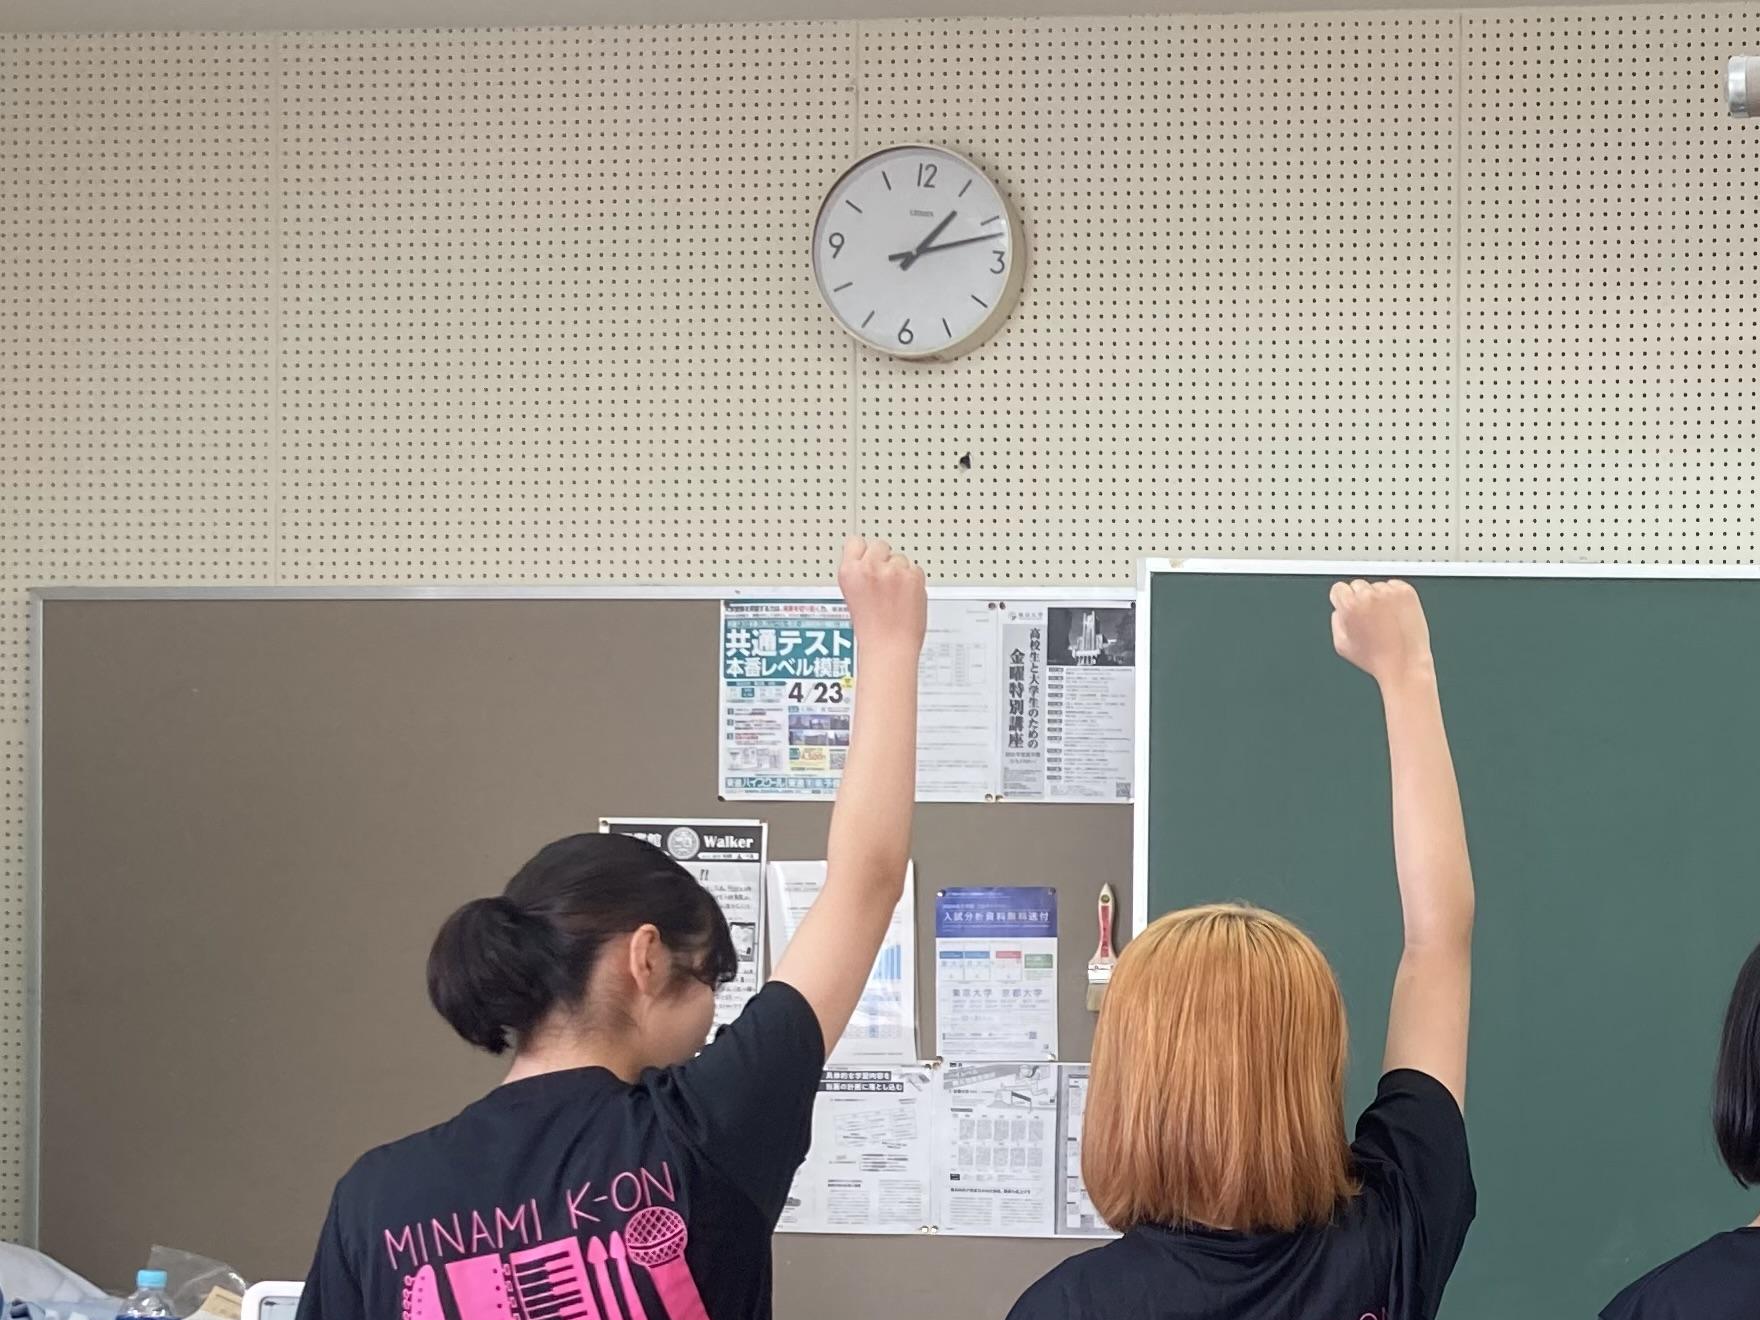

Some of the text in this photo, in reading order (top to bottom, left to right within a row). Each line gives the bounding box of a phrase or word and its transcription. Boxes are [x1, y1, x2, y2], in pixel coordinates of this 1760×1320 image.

[917, 163, 938, 188] 12
[829, 232, 845, 259] 9
[990, 250, 1005, 274] 3
[898, 318, 914, 345] 6
[726, 629, 851, 656] 共通テスト
[726, 658, 851, 677] 本番レベル模試
[788, 682, 843, 703] 4/23
[1008, 649, 1025, 748] 金曜特別講座
[1028, 628, 1041, 748] 高校生と大学生のための
[703, 835, 754, 848] Walker
[384, 1161, 675, 1270] MINAMI K-ON
